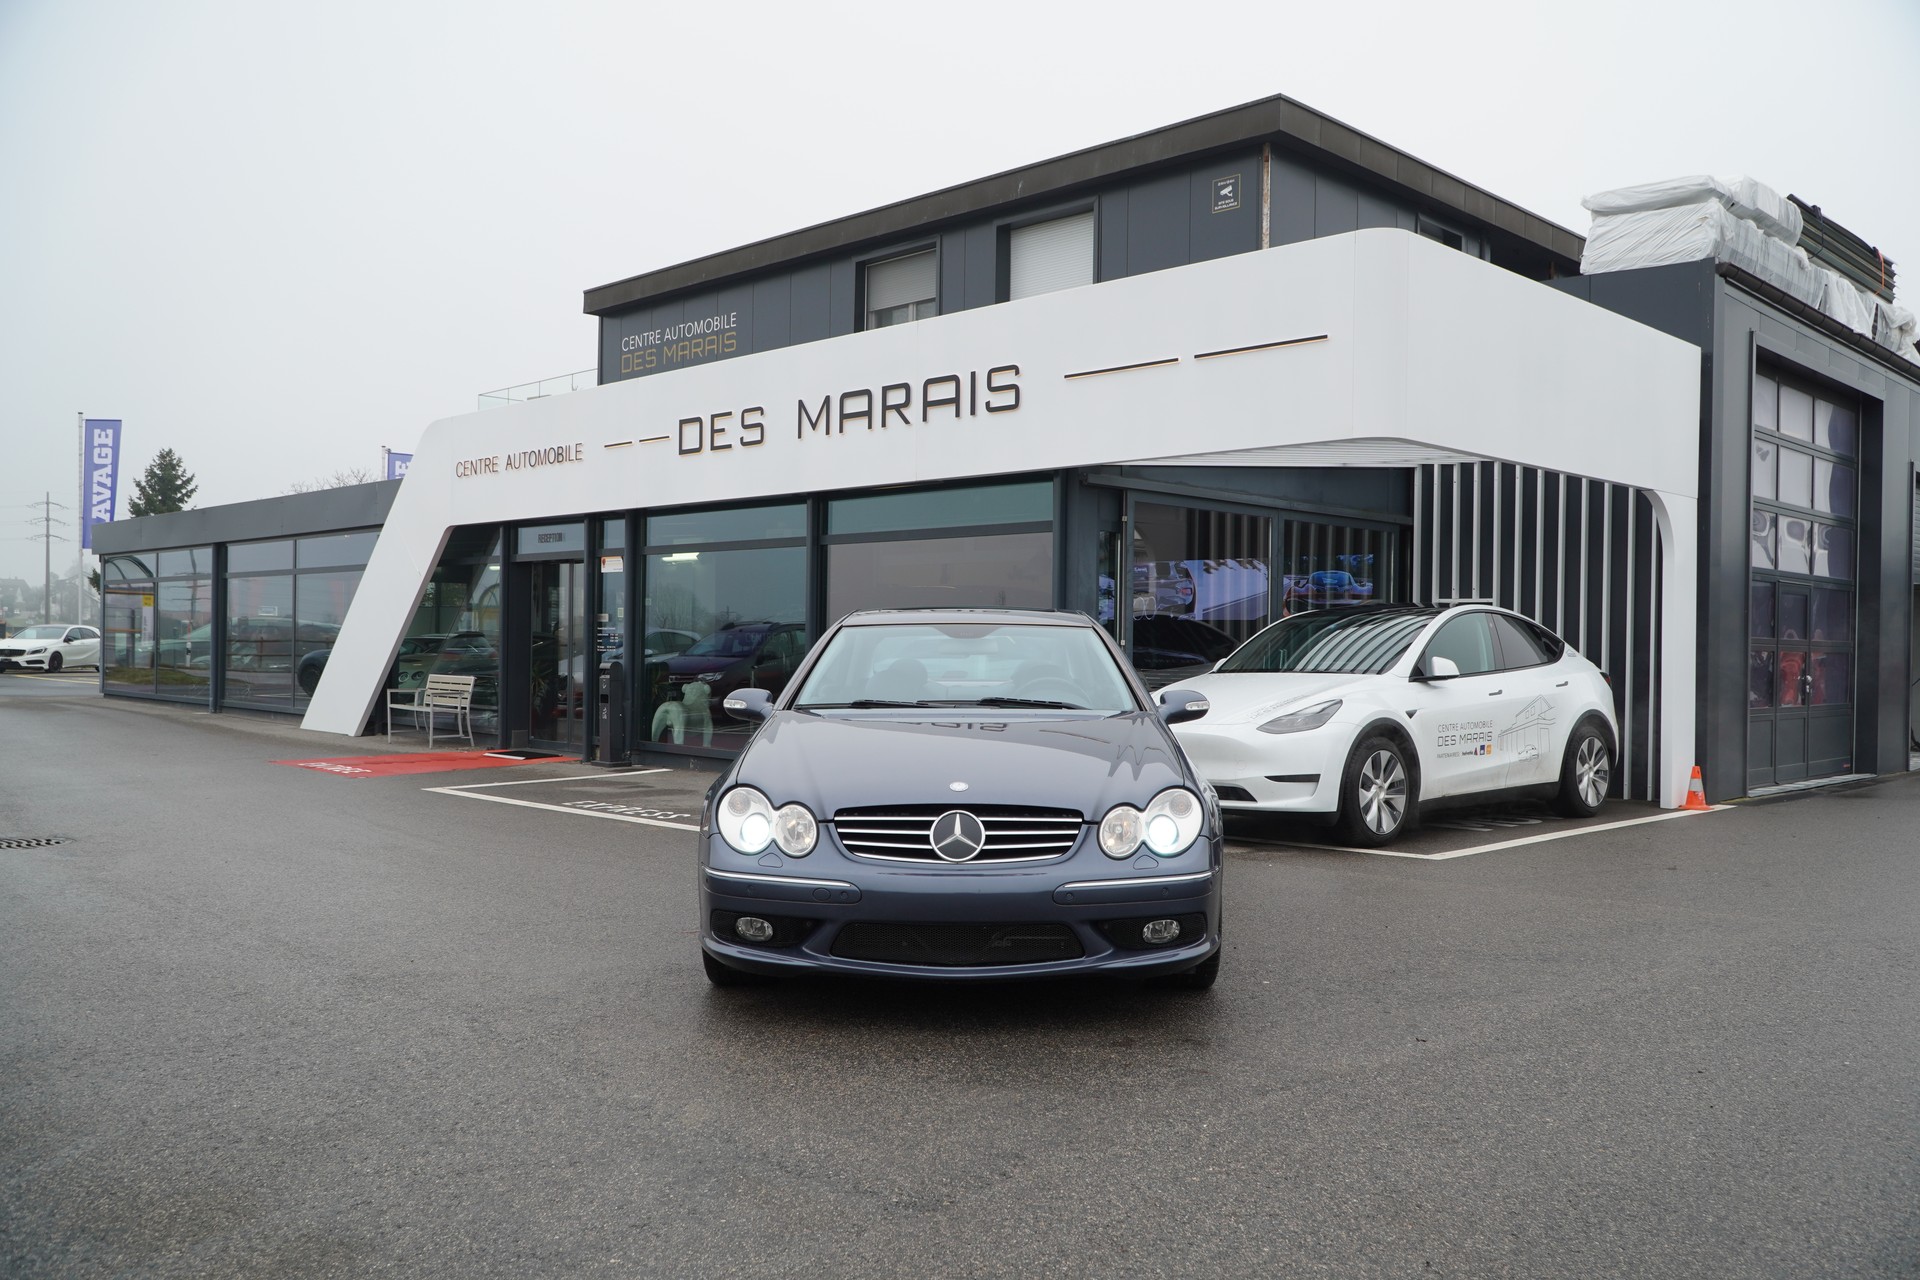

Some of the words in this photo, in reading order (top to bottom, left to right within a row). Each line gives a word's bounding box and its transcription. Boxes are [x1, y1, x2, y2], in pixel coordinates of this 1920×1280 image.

[621, 329, 661, 352] CENTRE
[664, 312, 737, 342] AUTOMOBILE
[621, 348, 657, 373] DES
[663, 331, 737, 365] MARAIS
[455, 455, 499, 478] CENTRE
[505, 442, 583, 471] AUTOMOBILE
[678, 406, 765, 456] DES
[797, 364, 1021, 440] MARAIS
[1437, 734, 1457, 747] DES
[1459, 731, 1493, 745] MARAIS
[1438, 722, 1459, 733] CENTRE
[1460, 720, 1493, 731] AUTOMOBILE
[562, 800, 691, 819] EXPRESS
